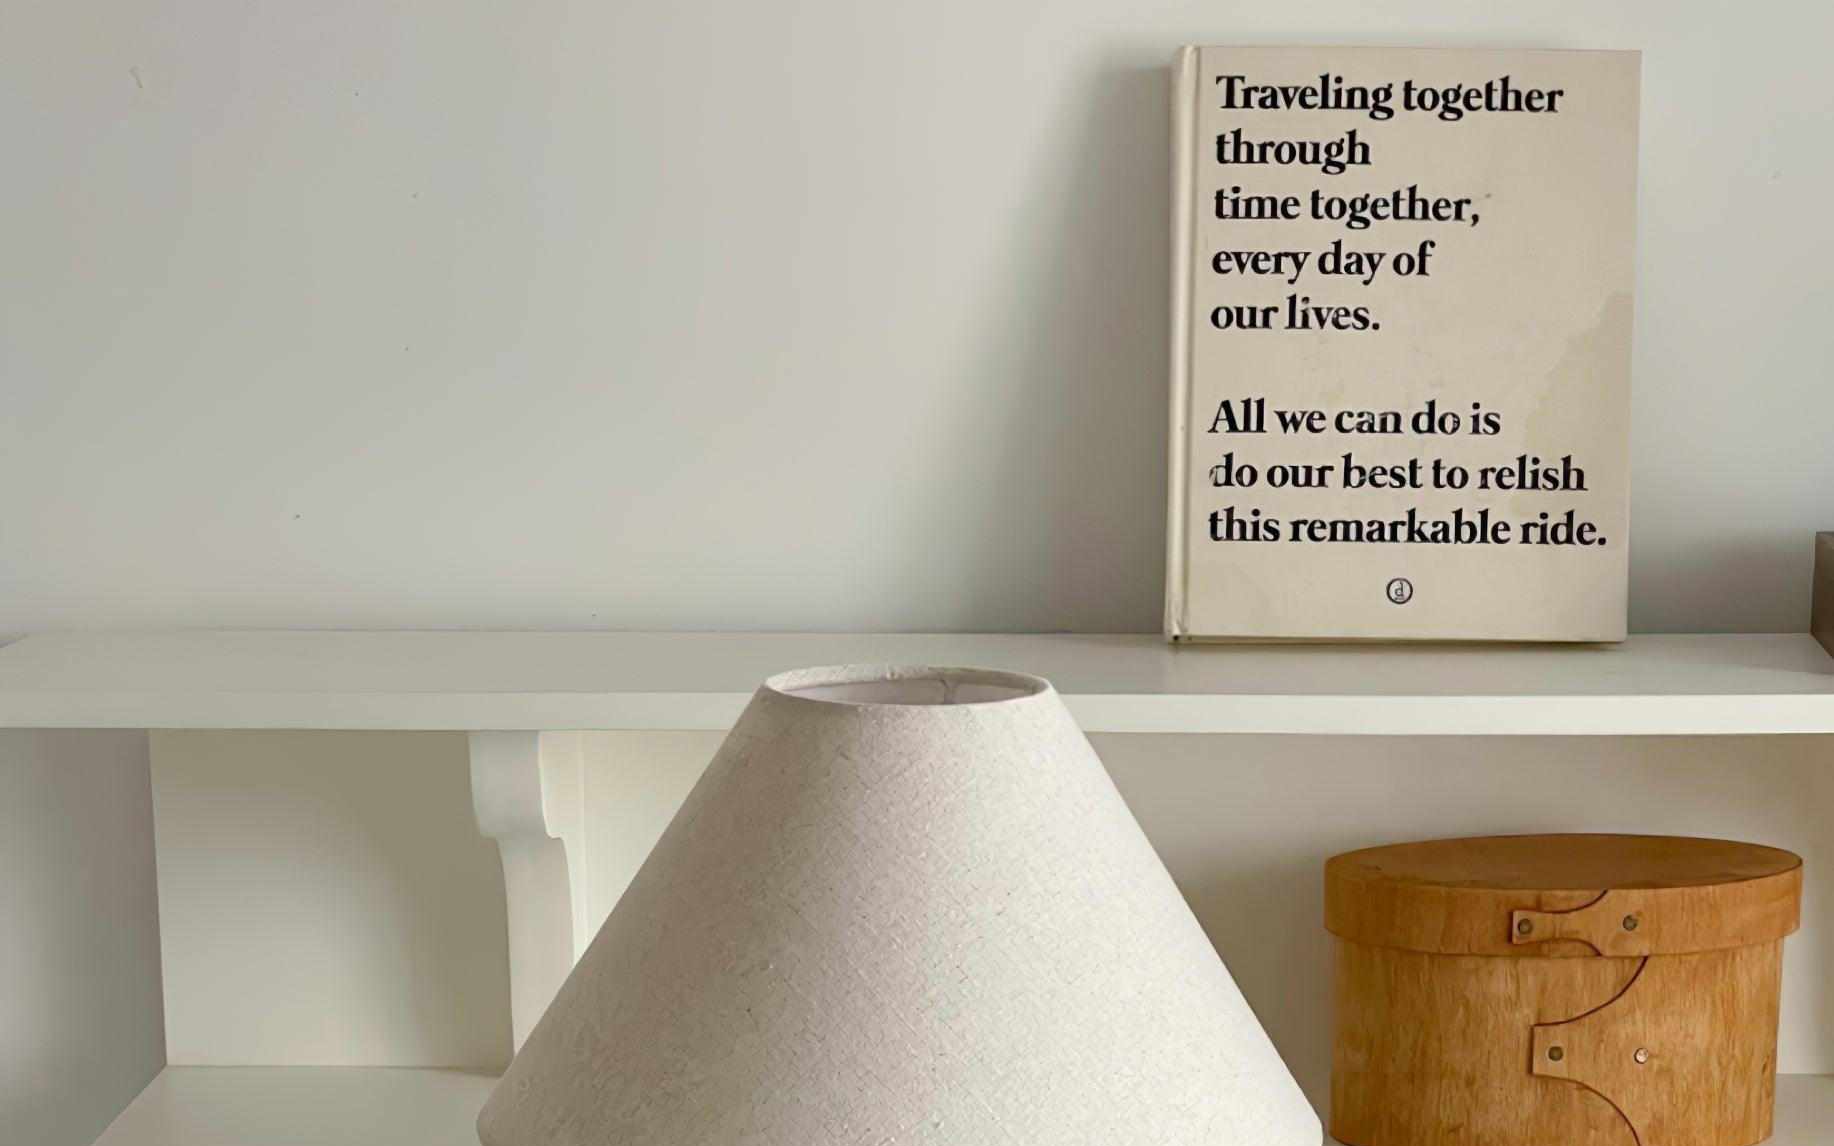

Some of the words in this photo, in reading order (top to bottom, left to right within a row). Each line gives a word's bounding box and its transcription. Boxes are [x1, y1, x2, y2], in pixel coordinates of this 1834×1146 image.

[1216, 73, 1394, 120] Traveling
[1403, 75, 1564, 121] together
[1216, 128, 1371, 175] through
[1214, 186, 1301, 220] time
[1311, 185, 1480, 229] together,
[1211, 248, 1311, 285] every
[1318, 239, 1386, 285] day
[1393, 239, 1436, 276] of
[1210, 307, 1278, 330] our
[1285, 294, 1381, 331] lives.
[1207, 398, 1267, 433] All
[1274, 409, 1327, 433] we
[1334, 409, 1404, 434] can
[1412, 399, 1461, 434] do
[1469, 403, 1501, 435] is
[1209, 452, 1259, 489] do
[1266, 464, 1335, 489] our
[1341, 453, 1424, 488] best
[1431, 458, 1469, 489] to
[1478, 454, 1589, 491] relish
[1208, 506, 1281, 542] this
[1288, 508, 1511, 544] remarkable
[1519, 509, 1607, 545] ride.
